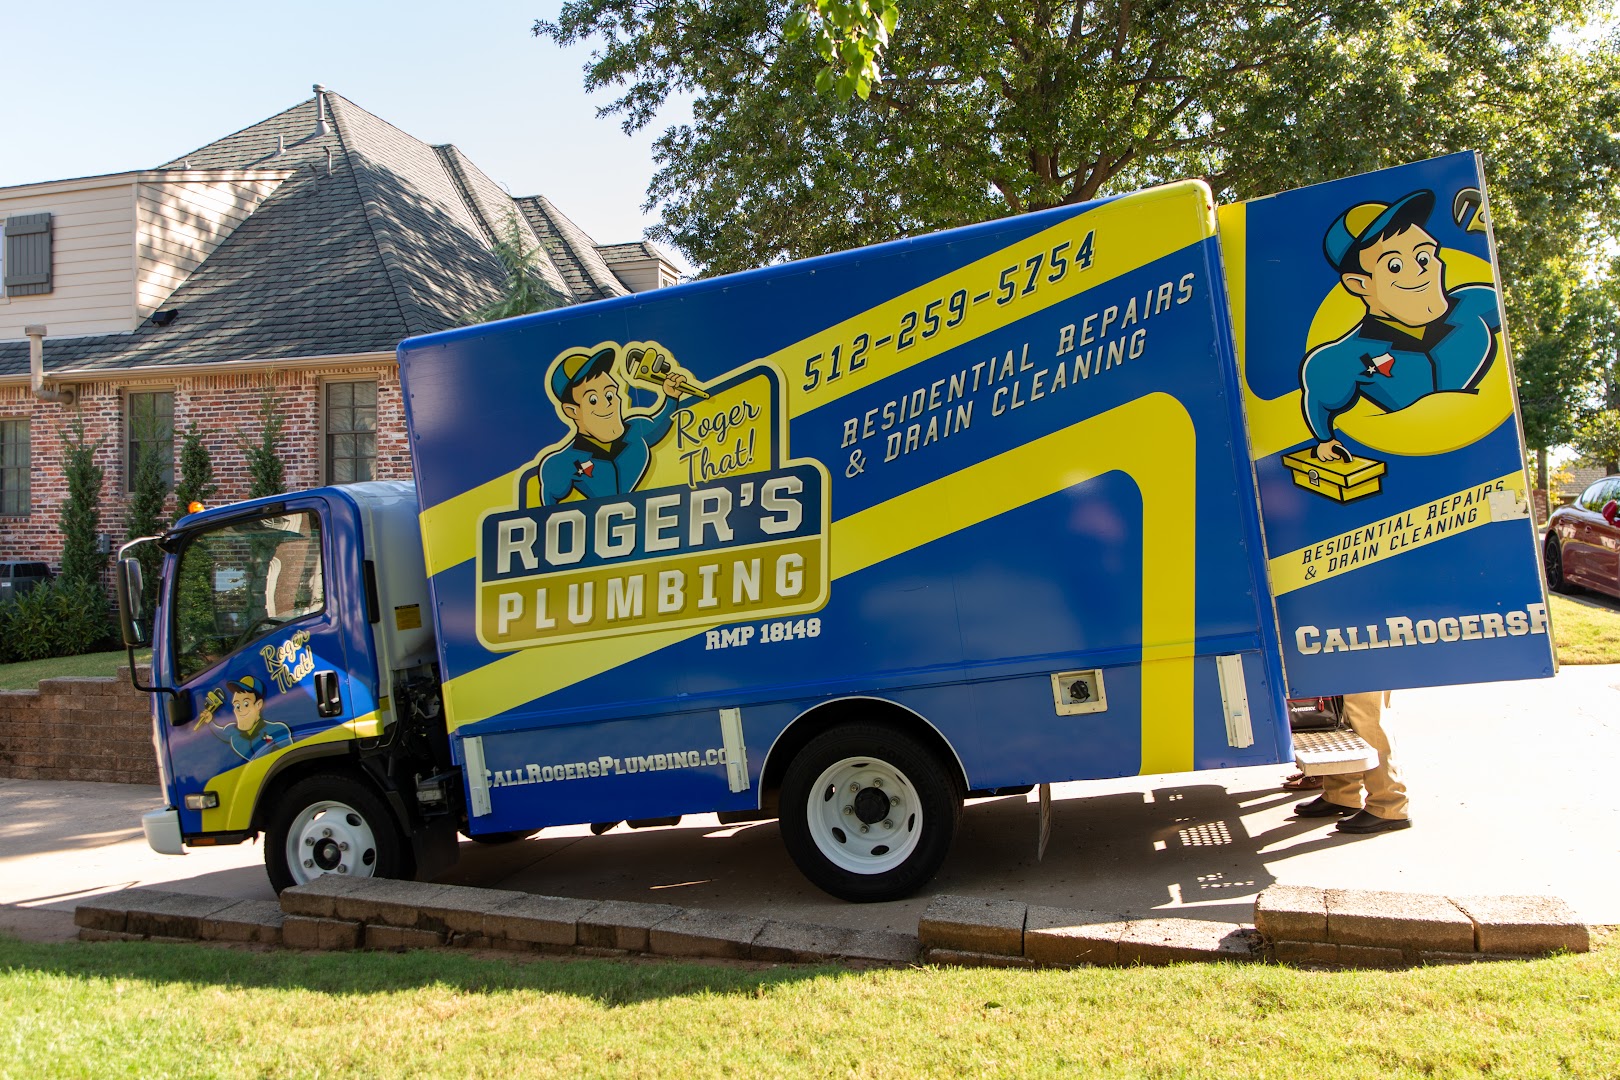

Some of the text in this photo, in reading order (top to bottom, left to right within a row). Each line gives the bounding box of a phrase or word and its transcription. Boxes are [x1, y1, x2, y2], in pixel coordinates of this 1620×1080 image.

[802, 229, 1096, 393] 512-259-5754
[841, 272, 1196, 449] RESIDENTIAL REPAIRS
[671, 398, 761, 450] Roger
[845, 328, 1147, 479] & DRAIN CLEANING
[678, 428, 755, 488] That!
[496, 475, 804, 575] ROGER'S
[1301, 513, 1414, 565] RESIDENTIAL
[1304, 507, 1478, 581] & DRAIN CLEANING
[497, 552, 805, 635] PLUMBING
[260, 629, 310, 673] Roger
[705, 617, 821, 650] RMP 18148
[271, 645, 315, 694] That!
